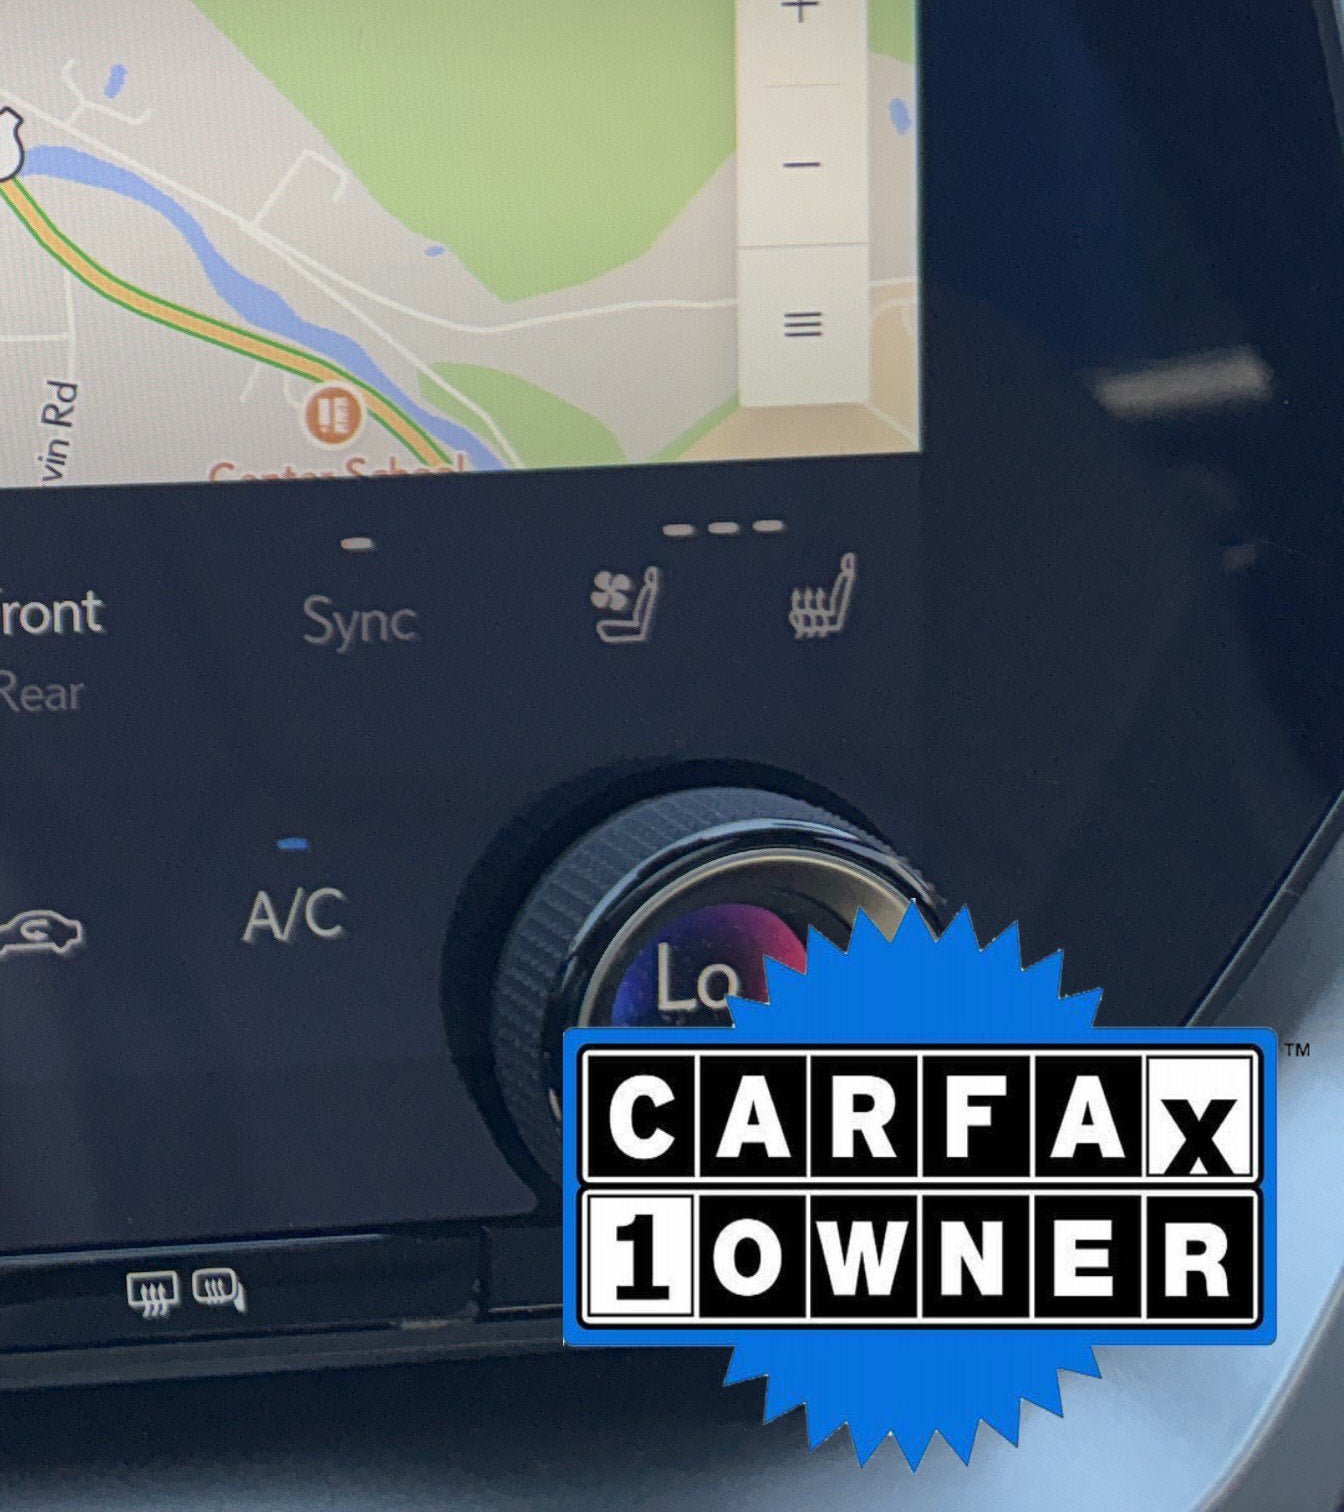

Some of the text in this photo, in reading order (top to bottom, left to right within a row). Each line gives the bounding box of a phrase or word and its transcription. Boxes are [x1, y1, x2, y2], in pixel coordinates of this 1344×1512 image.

[41, 379, 78, 427] Rd
[302, 594, 418, 654] Sync
[242, 887, 344, 943] A/C
[658, 941, 739, 1011] Lo
